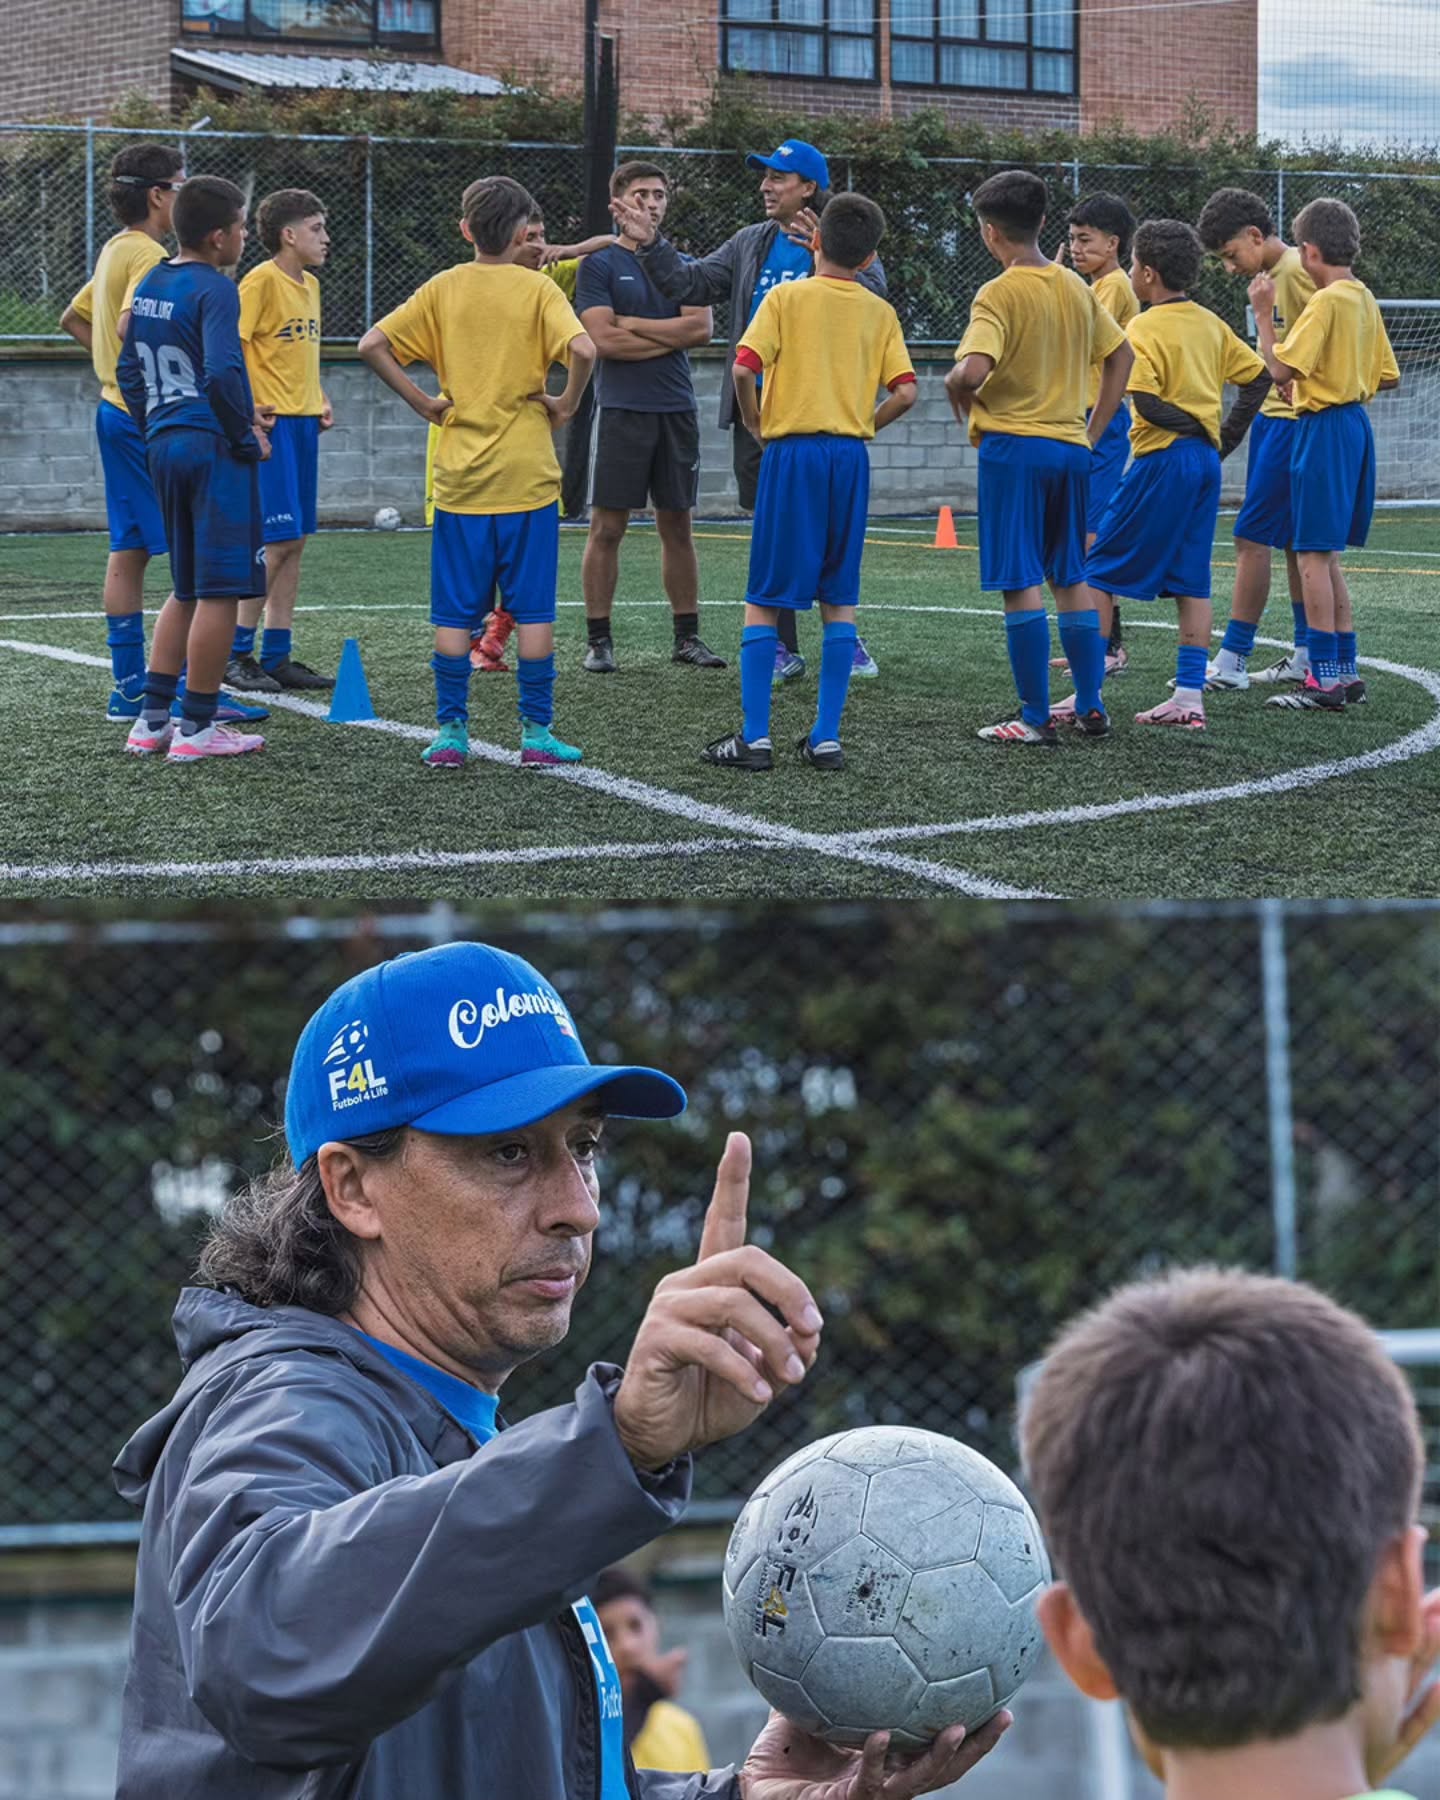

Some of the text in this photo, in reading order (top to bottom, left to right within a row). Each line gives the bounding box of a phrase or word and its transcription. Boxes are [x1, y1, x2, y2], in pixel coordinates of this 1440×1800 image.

[448, 986, 569, 1049] Colombi
[328, 1059, 387, 1101] F4L
[332, 1093, 363, 1112] Futbol
[363, 1091, 370, 1101] 4
